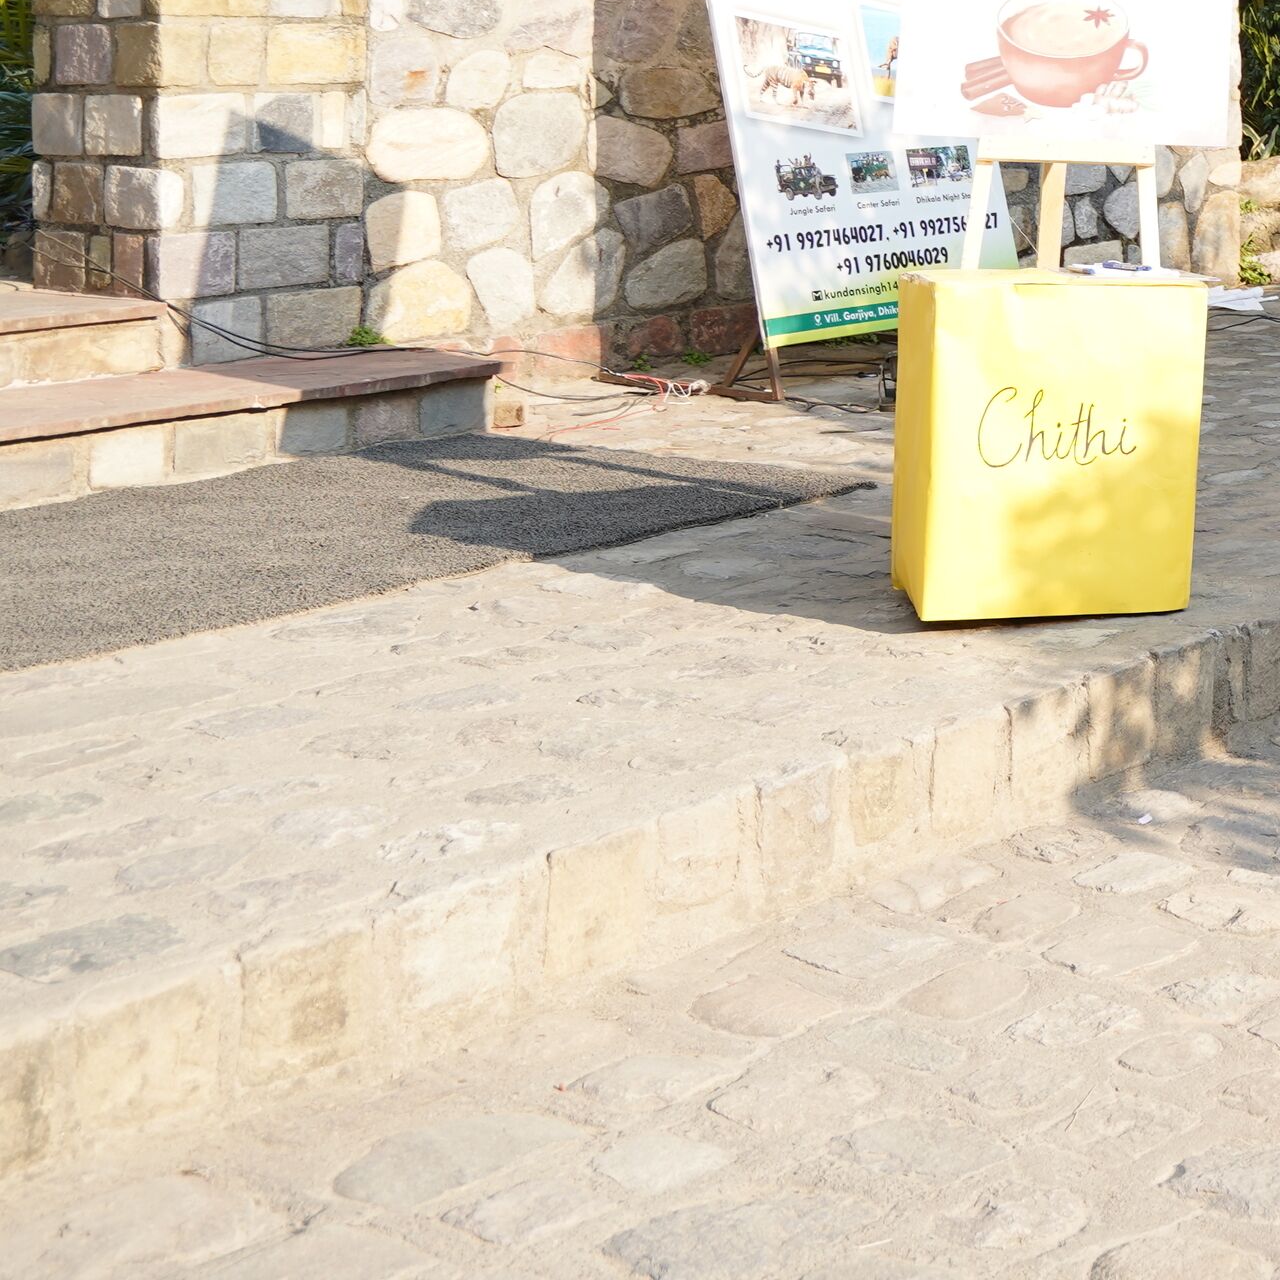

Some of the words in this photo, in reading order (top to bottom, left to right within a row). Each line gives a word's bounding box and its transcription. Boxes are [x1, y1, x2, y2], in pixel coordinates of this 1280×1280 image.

[857, 200, 879, 210] Canter
[880, 198, 900, 207] Safari
[916, 195, 941, 204] Dhikala
[942, 193, 960, 202] Night
[961, 192, 971, 200] Sta
[790, 206, 813, 216] Jungle
[815, 204, 836, 214] Safari
[766, 233, 791, 252] +91
[893, 221, 915, 239] +91
[920, 212, 997, 237] 99275627
[837, 256, 860, 275] +91
[865, 246, 948, 273] 9760046029
[824, 313, 842, 324] Vill.
[843, 309, 877, 322] Garjiya,
[978, 386, 1137, 468] Chithi
